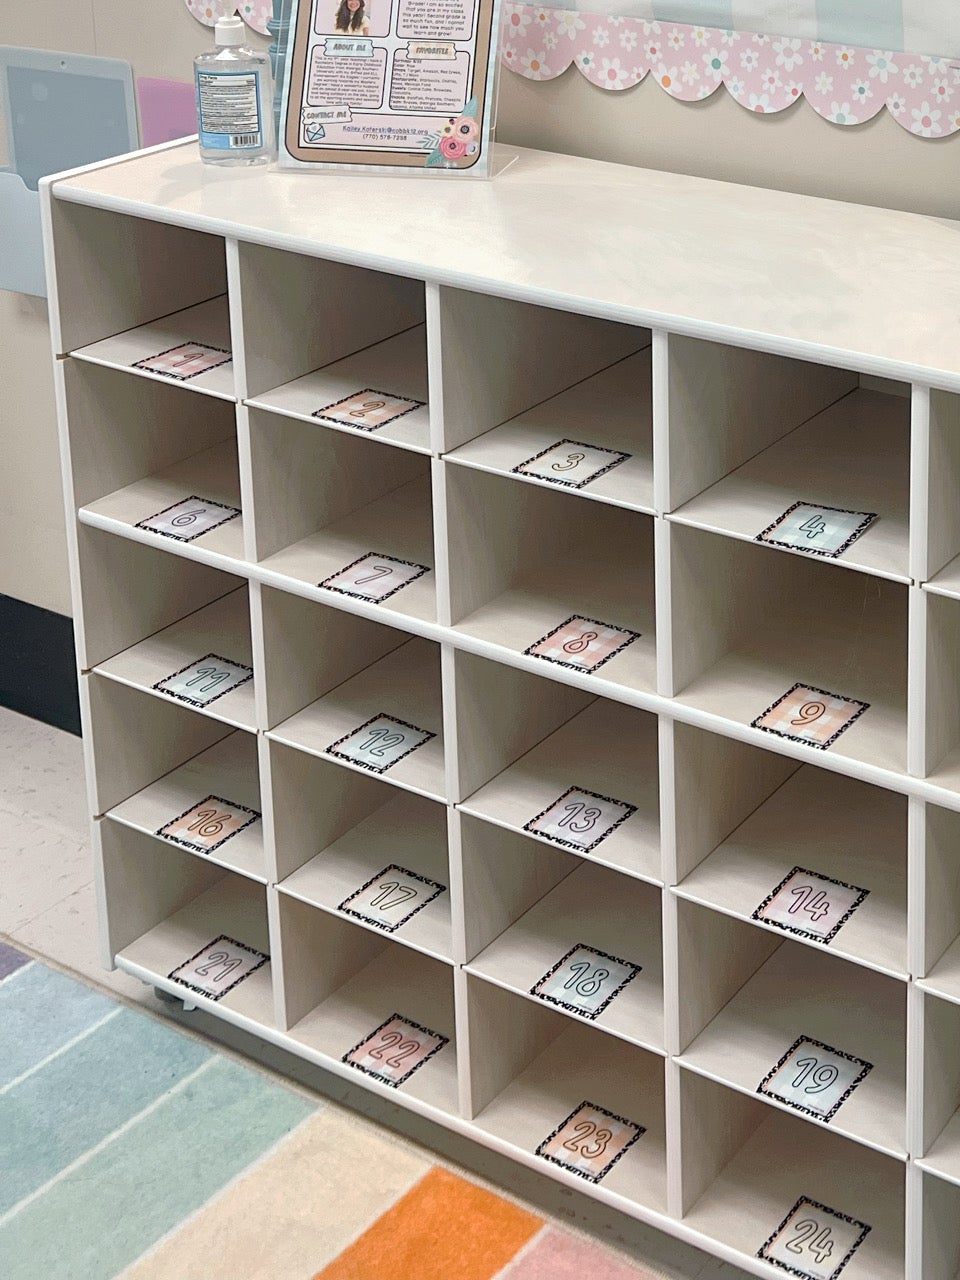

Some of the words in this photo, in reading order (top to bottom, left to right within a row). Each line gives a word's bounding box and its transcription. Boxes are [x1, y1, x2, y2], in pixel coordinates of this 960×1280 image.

[173, 352, 203, 368] 1
[349, 401, 386, 418] 2
[552, 452, 586, 472] 3
[171, 509, 204, 527] 6
[799, 514, 826, 539] 4
[355, 565, 393, 585] 7
[562, 631, 598, 655] 8
[186, 667, 229, 692] 11
[790, 701, 828, 726] 9
[360, 727, 405, 757] 12
[187, 809, 232, 837] 16
[558, 801, 602, 834] 13
[370, 881, 418, 911] 17
[787, 885, 831, 922] 14
[196, 952, 243, 982] 21
[563, 961, 610, 997] 18
[368, 1031, 420, 1068] 22
[786, 1057, 839, 1095] 19
[562, 1120, 613, 1159] 23
[785, 1218, 834, 1264] 24
